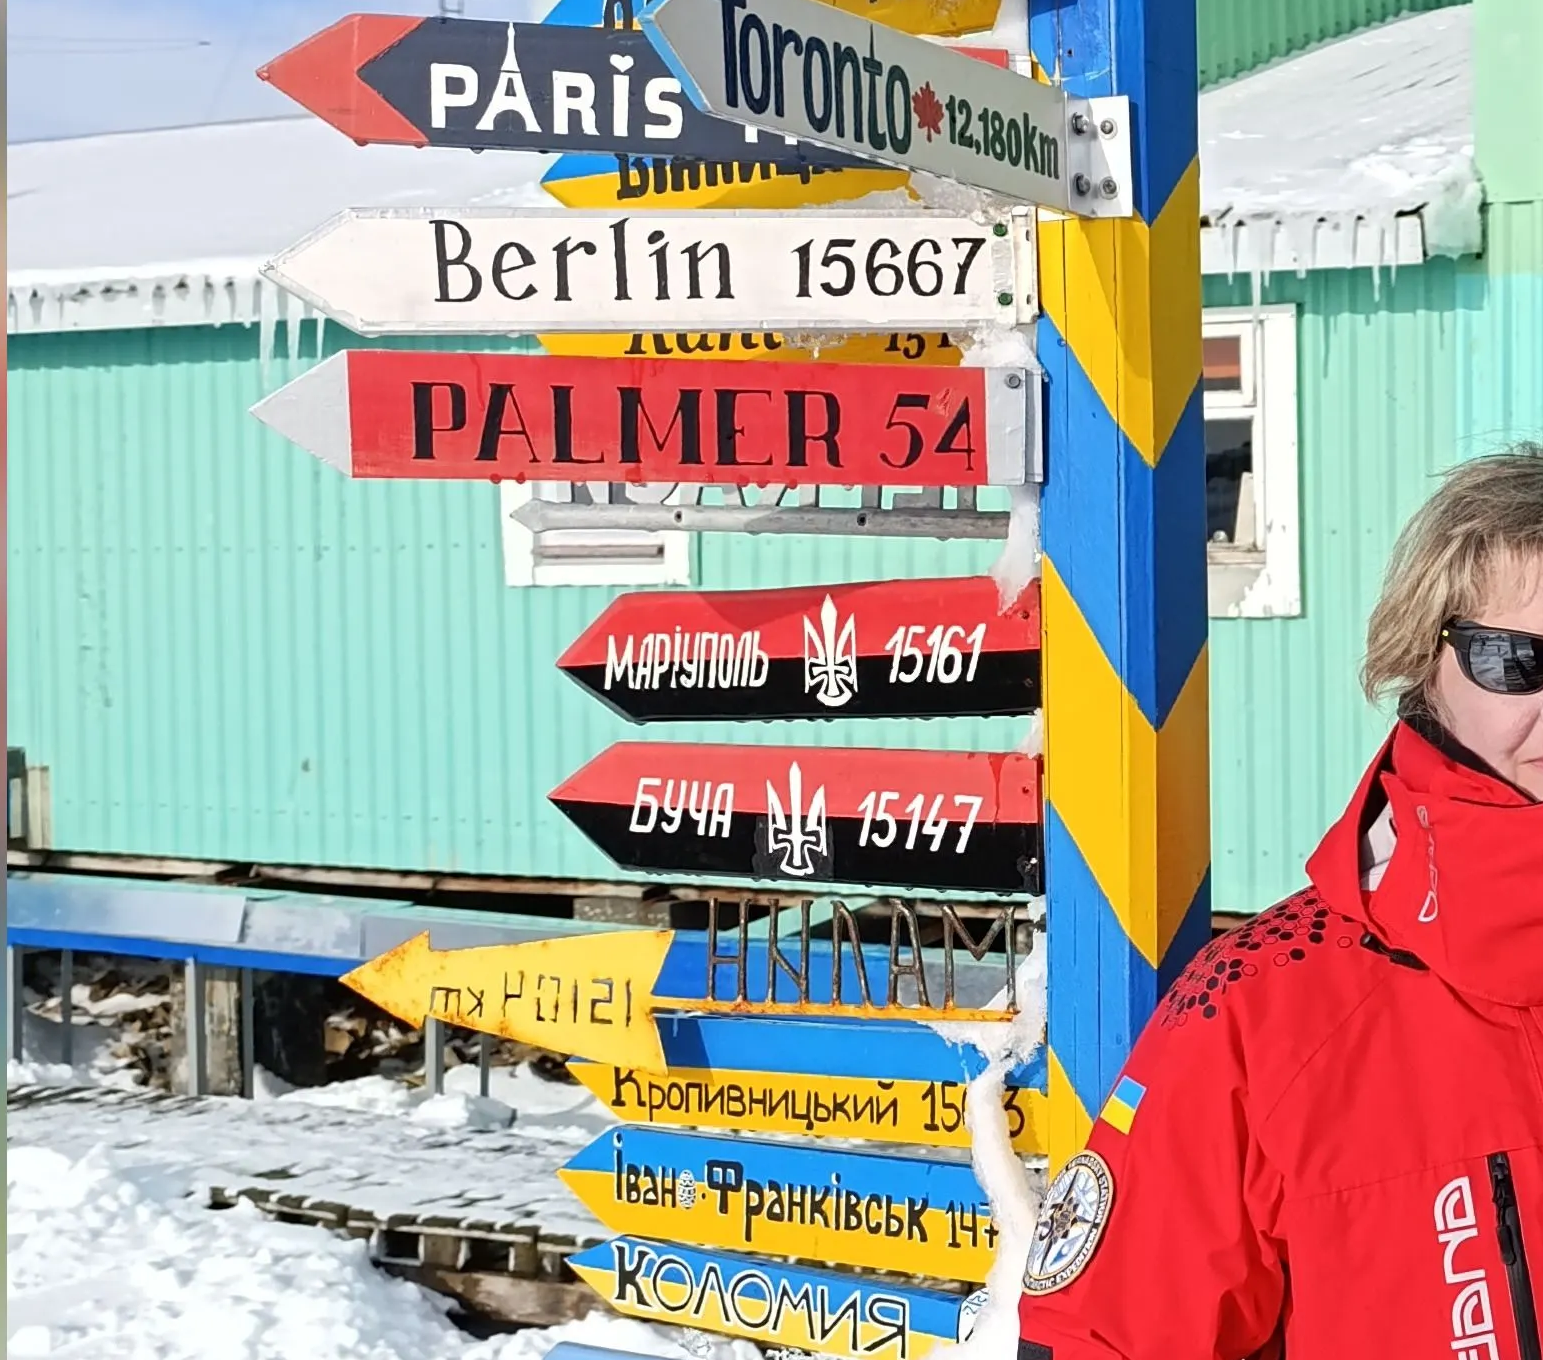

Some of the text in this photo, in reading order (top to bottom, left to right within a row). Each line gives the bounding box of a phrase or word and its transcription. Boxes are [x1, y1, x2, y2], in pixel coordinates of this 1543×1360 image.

[428, 217, 986, 305] Berlin 15667
[411, 382, 976, 471] PALMER 54
[884, 623, 987, 684] 15161
[629, 777, 984, 854] БУЧА 15147
[611, 1067, 900, 1131] Кропивницький
[612, 1244, 911, 1360] КОЛОМИЯ
